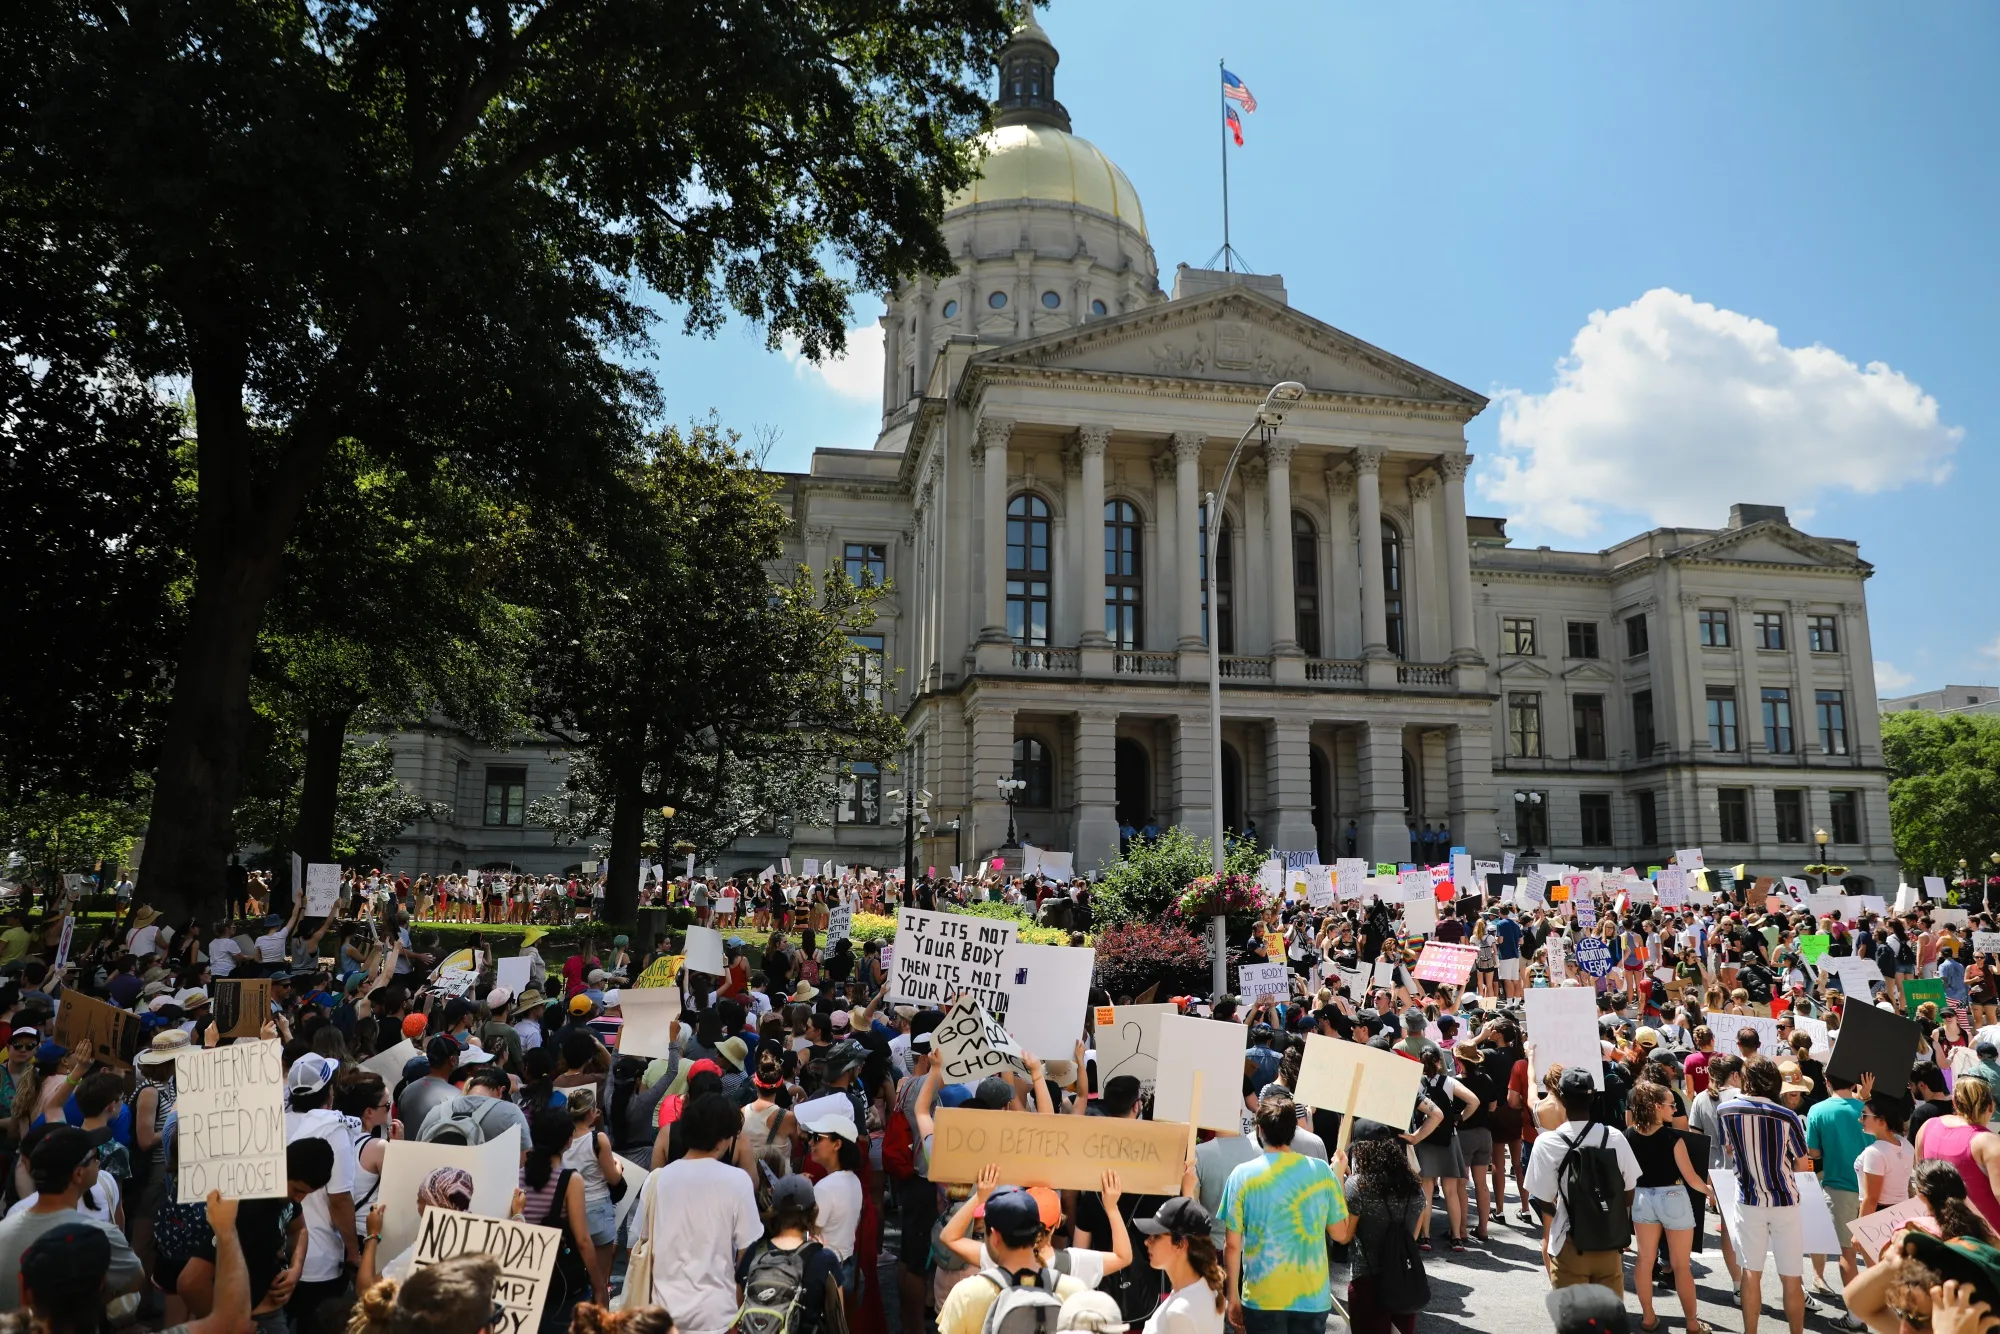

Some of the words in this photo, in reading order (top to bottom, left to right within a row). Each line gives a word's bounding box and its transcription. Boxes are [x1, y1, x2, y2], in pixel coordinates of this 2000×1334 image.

[904, 915, 930, 933] IF
[940, 921, 968, 940] ITS
[978, 926, 1009, 945] NOT
[1580, 938, 1601, 949] KEEP
[913, 934, 956, 960] YOUR
[961, 941, 1004, 968] BODY
[1577, 947, 1611, 963] ABORTION
[901, 957, 931, 977] THEN
[935, 963, 960, 983] ITS
[971, 969, 1002, 990] NOT
[1244, 971, 1254, 981] MY
[1262, 968, 1283, 979] BODY
[1421, 969, 1458, 979] RIGHTS
[1583, 959, 1611, 973] LEGAL
[898, 973, 940, 1002] YOUR
[1241, 985, 1251, 996] MY
[1254, 982, 1288, 995] FREEDOM
[1709, 1014, 1736, 1033] HER
[1740, 1018, 1774, 1042] BODY
[176, 1039, 282, 1094] SOUTHERNERS
[214, 1089, 240, 1109] FOR
[178, 1104, 283, 1164] FREEDOM
[945, 1126, 986, 1152] DO
[1000, 1126, 1070, 1157] BETTER
[1082, 1133, 1161, 1163] GEORGIA
[179, 1163, 207, 1199] TO
[217, 1160, 278, 1195] CHOOSE!
[418, 1210, 479, 1262] NOT
[483, 1219, 557, 1271] TODAY
